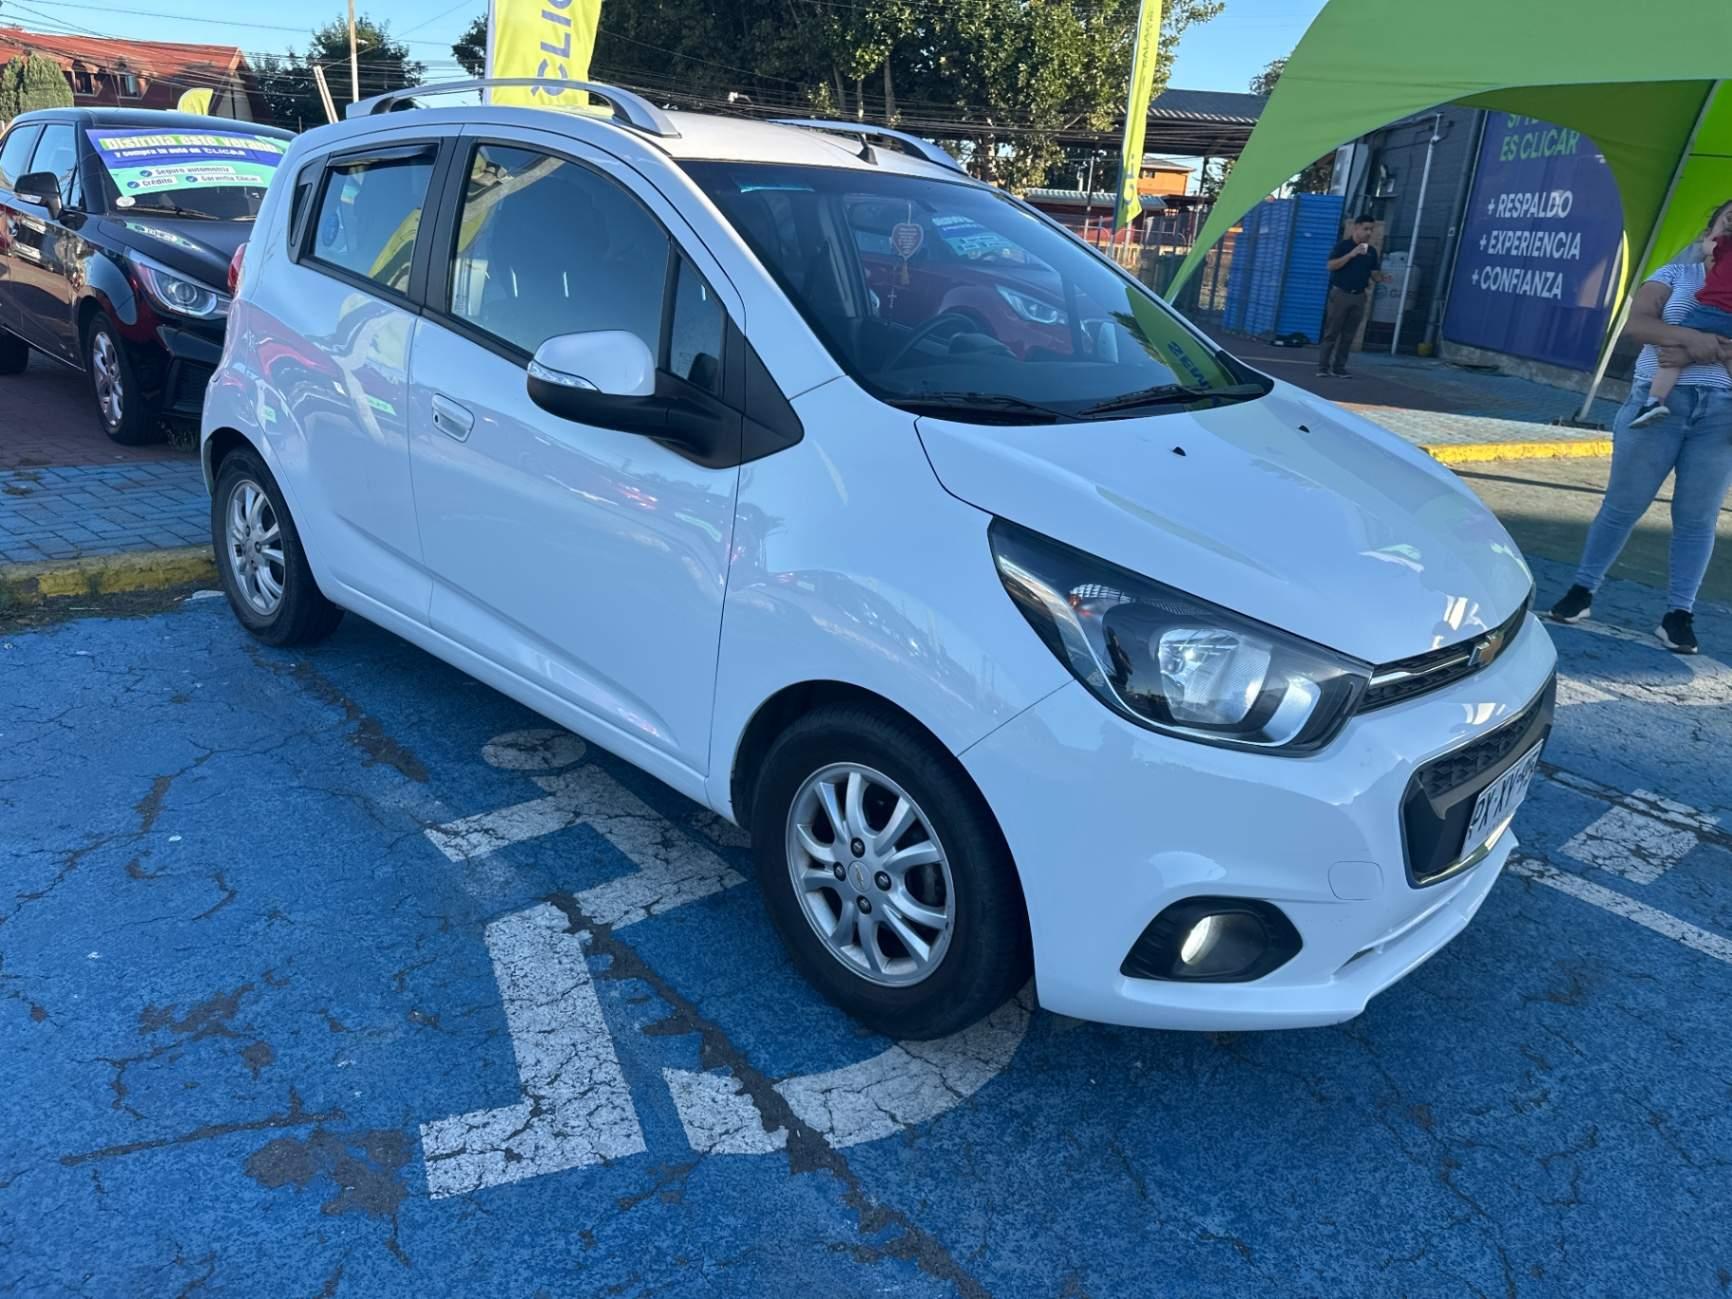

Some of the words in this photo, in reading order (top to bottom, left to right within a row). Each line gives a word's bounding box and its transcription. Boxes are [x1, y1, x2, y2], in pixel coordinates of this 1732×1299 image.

[533, 0, 573, 96] CLI
[1500, 134, 1519, 161] ES
[1520, 128, 1580, 160] CLICAR
